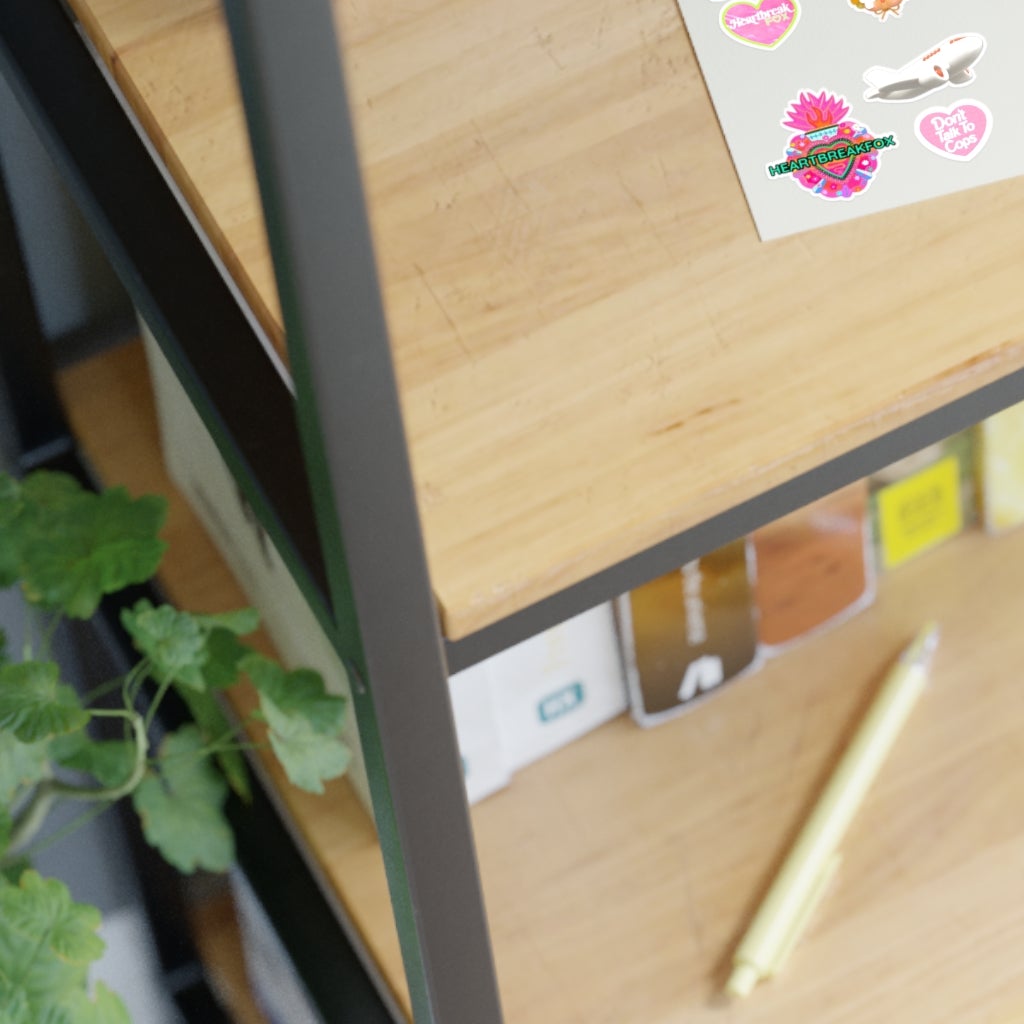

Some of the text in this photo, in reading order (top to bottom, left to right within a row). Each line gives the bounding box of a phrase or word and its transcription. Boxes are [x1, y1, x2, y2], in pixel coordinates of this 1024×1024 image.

[958, 120, 976, 134] To
[944, 134, 978, 153] Cops
[768, 135, 896, 177] HEARTBREAKFOX
